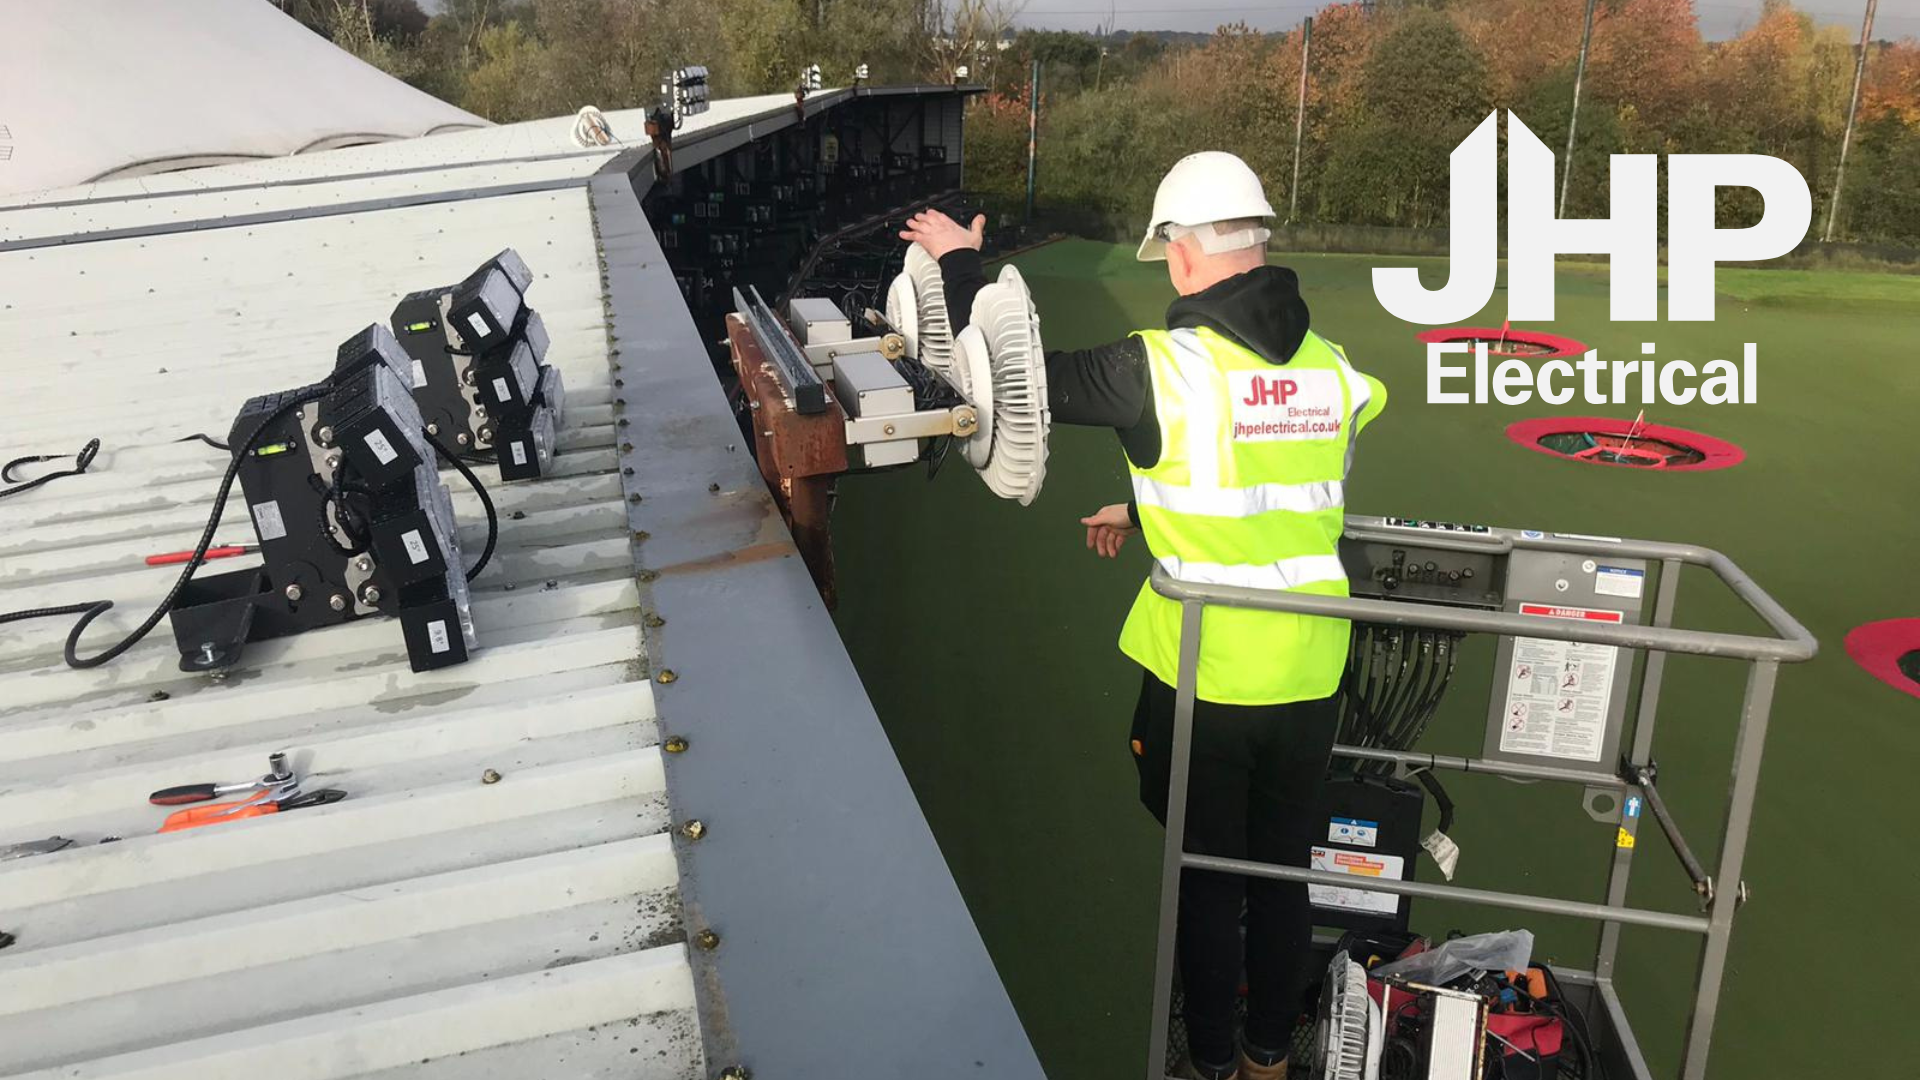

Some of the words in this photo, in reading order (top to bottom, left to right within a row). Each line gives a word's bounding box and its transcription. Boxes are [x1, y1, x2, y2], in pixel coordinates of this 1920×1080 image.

[1243, 374, 1298, 406] JHP
[1287, 407, 1330, 418] Electrical
[1233, 419, 1341, 438] jhpelectrical.co.uk
